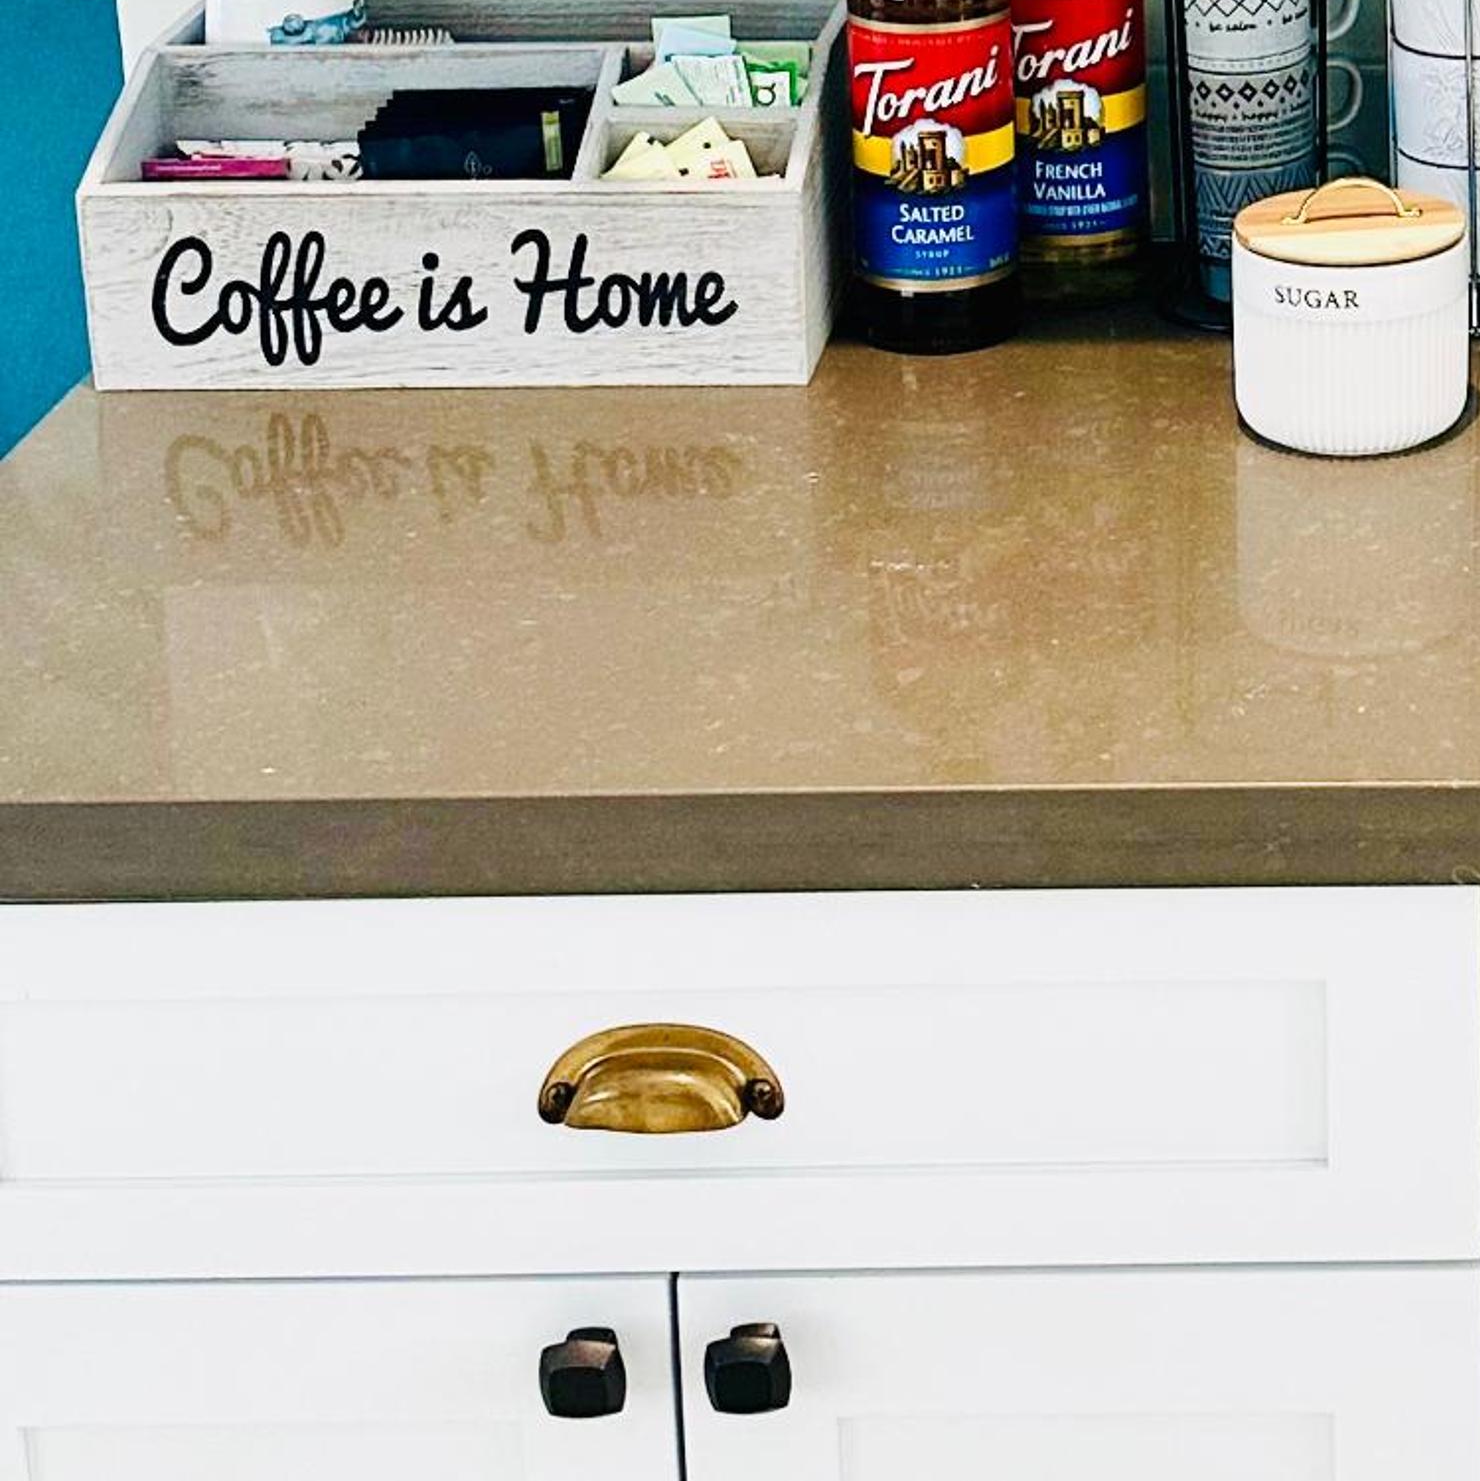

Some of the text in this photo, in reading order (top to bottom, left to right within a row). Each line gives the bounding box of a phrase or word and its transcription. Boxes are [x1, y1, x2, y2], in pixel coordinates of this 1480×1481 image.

[1010, 8, 1133, 81] Torani
[853, 45, 999, 139] Torani
[1034, 160, 1104, 180] FRENCH
[1033, 180, 1107, 201] VANILLA
[899, 202, 965, 223] SALTED
[891, 224, 975, 245] CARAMEL
[151, 228, 739, 367] Coffee is Home
[1273, 284, 1360, 309] SUGAR
